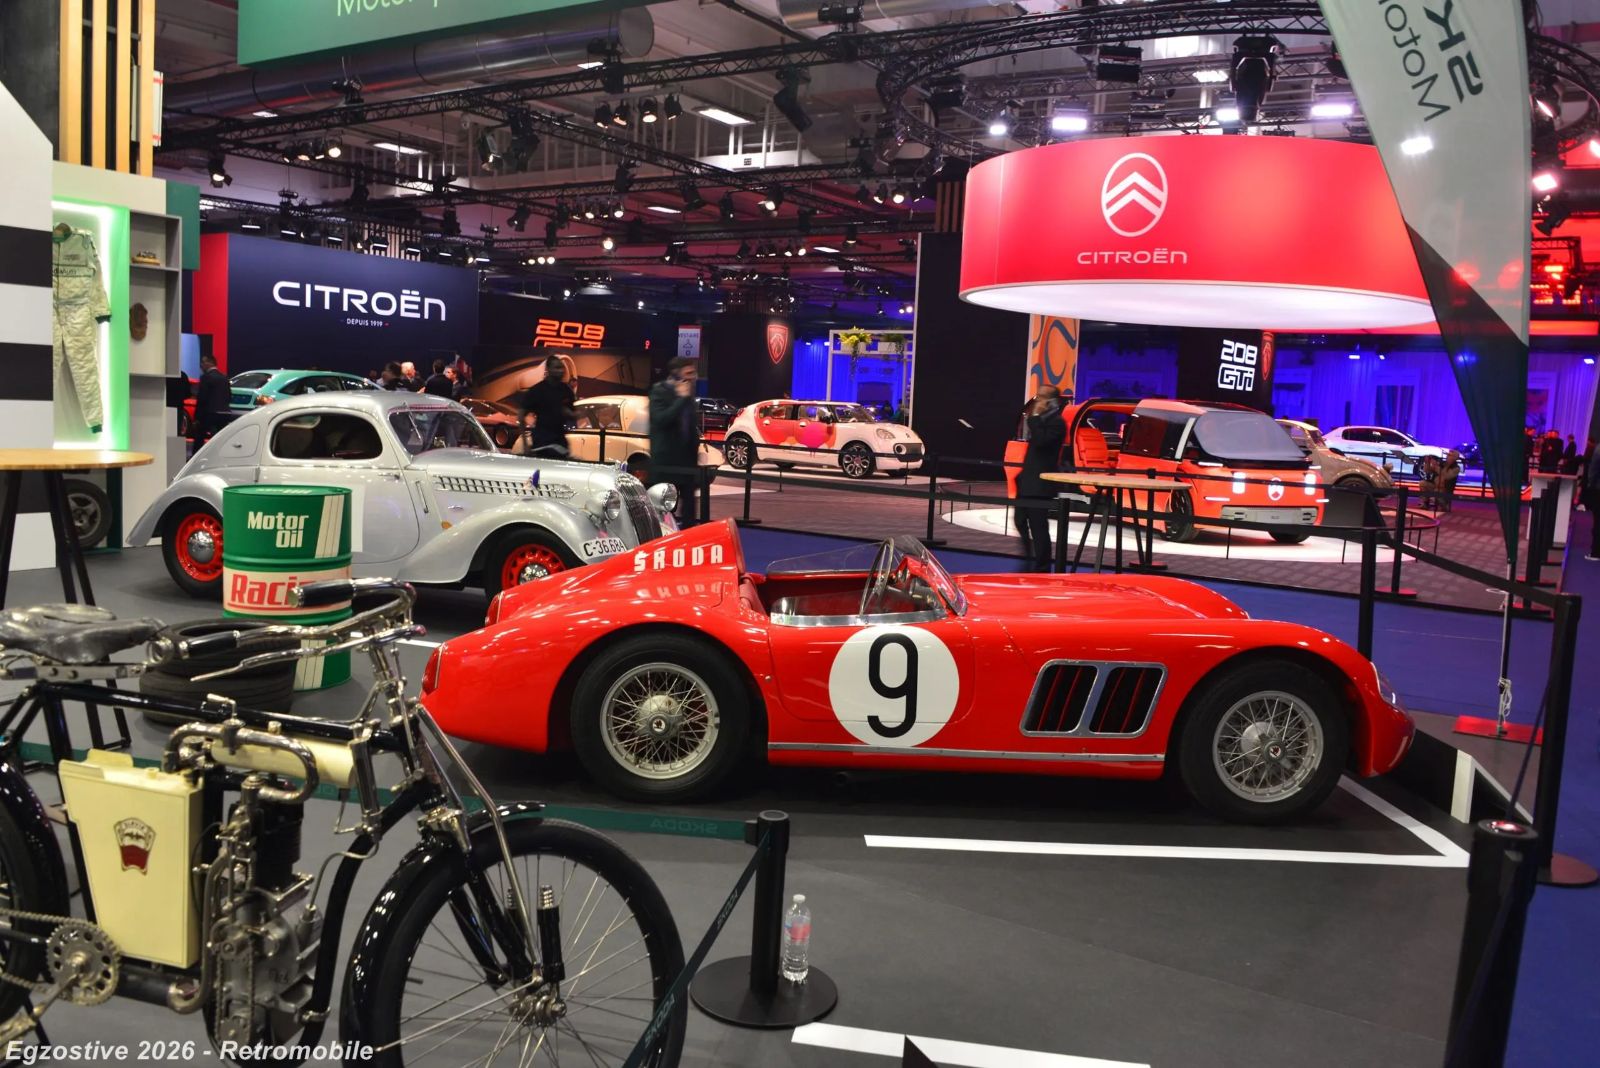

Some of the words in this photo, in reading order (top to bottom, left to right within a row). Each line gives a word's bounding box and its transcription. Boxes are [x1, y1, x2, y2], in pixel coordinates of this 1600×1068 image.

[346, 318, 369, 326] DEPUIS
[535, 318, 605, 340] 208
[1220, 339, 1258, 366] 208
[247, 511, 309, 530] Motor
[275, 530, 303, 548] Oil
[867, 633, 918, 738] 9
